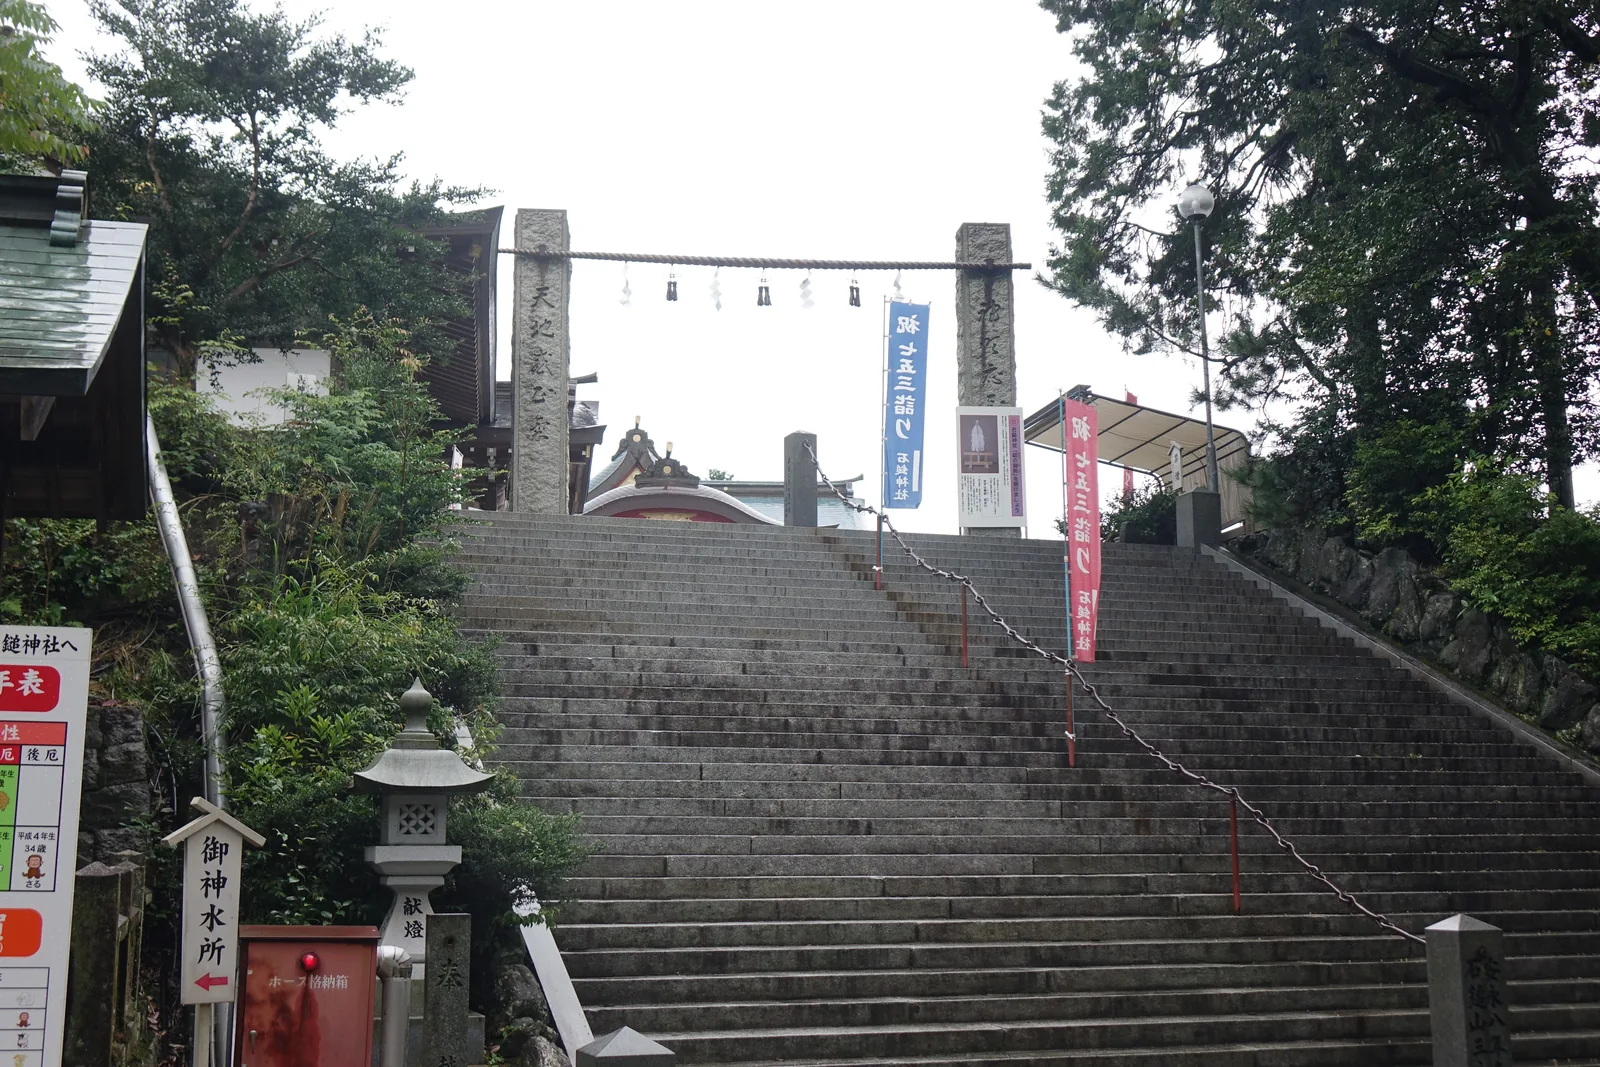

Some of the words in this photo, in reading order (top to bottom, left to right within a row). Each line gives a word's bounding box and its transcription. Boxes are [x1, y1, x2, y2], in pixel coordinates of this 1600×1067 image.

[2, 633, 79, 656] 鎚神社へ
[25, 880, 41, 889] さる
[197, 836, 229, 966] 御神水所
[403, 897, 424, 939] 献燈
[269, 974, 348, 989] ホース格納箱
